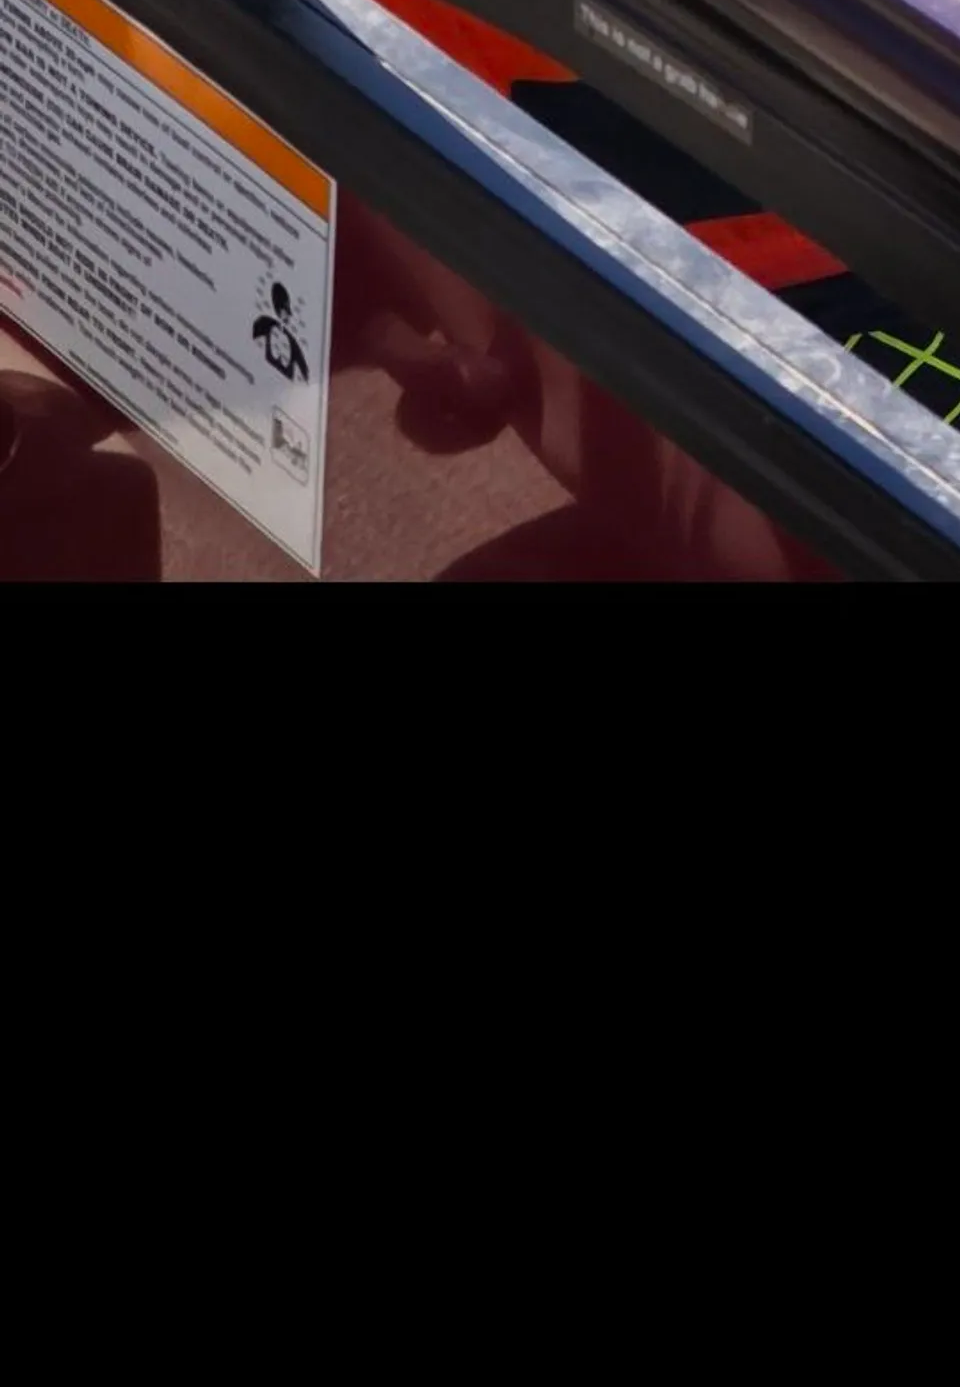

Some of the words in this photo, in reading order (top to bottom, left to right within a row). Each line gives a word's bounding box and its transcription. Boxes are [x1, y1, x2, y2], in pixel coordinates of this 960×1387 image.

[580, 2, 610, 37] This
[612, 27, 626, 49] is
[627, 36, 652, 65] not
